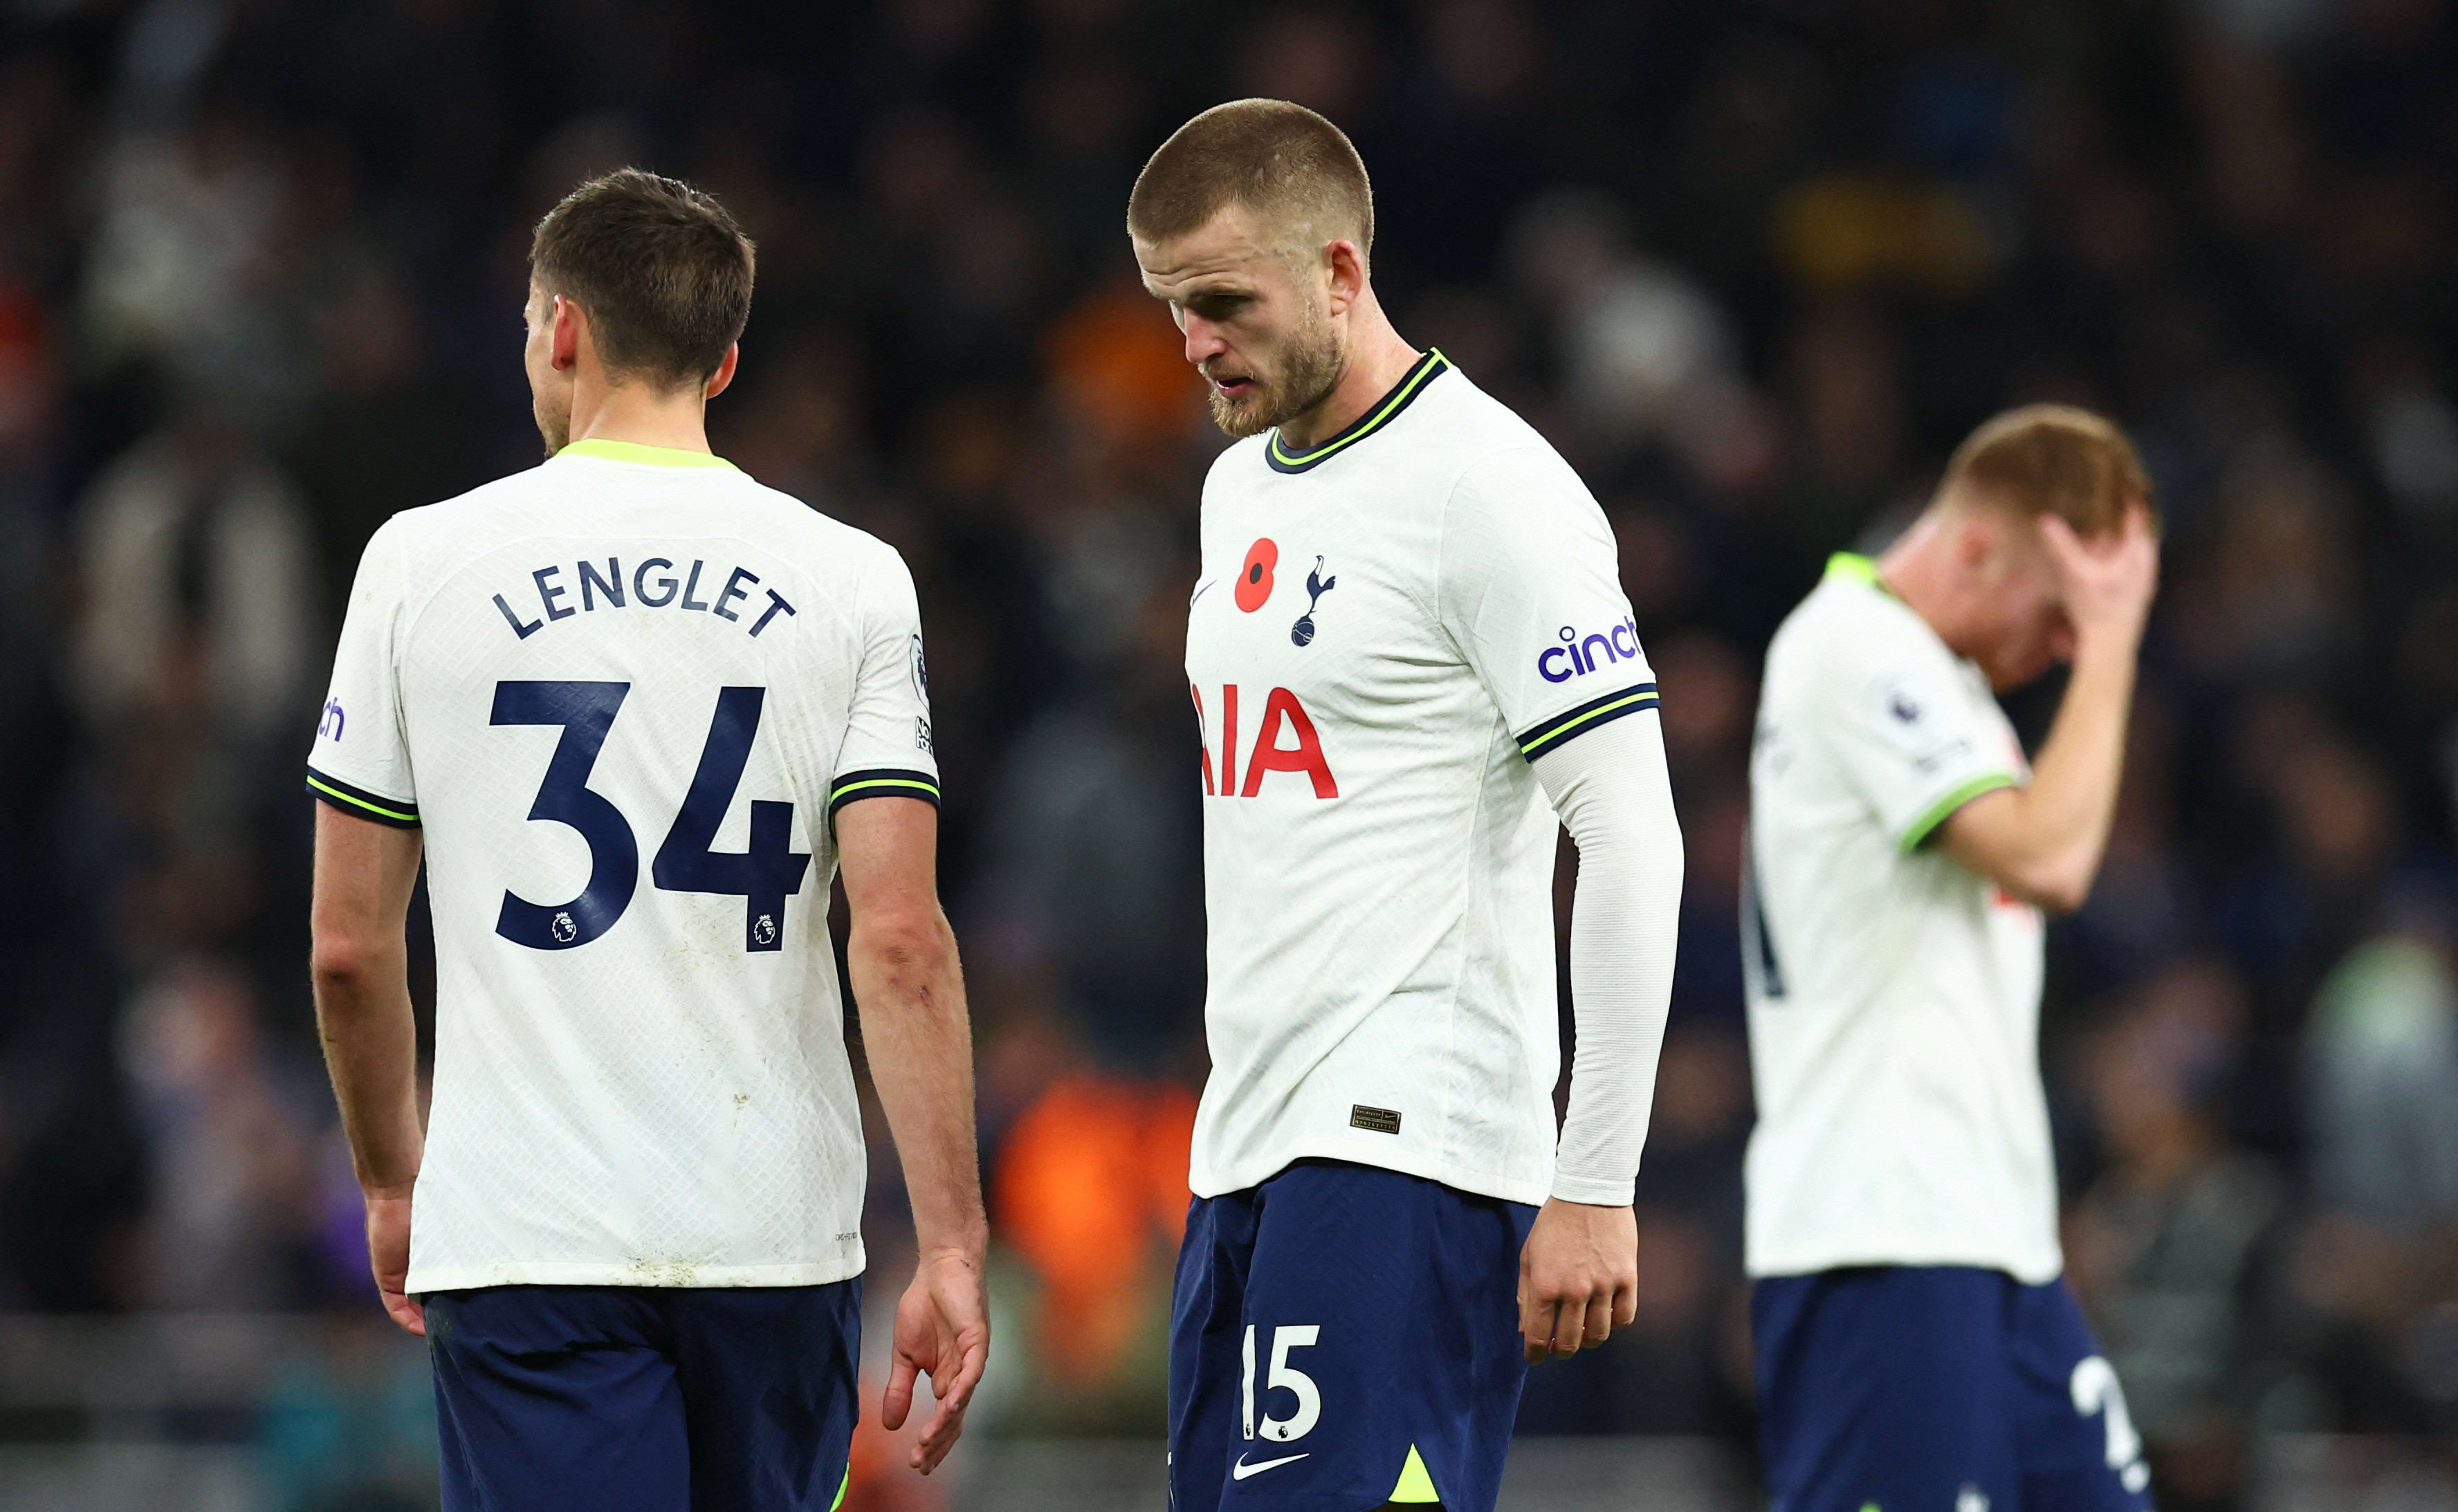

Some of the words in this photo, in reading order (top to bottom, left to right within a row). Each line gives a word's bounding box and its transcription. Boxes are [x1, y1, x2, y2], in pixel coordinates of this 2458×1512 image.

[491, 557, 797, 640] LENGLET
[488, 681, 812, 952] 34
[1242, 1324, 1321, 1443] 15
